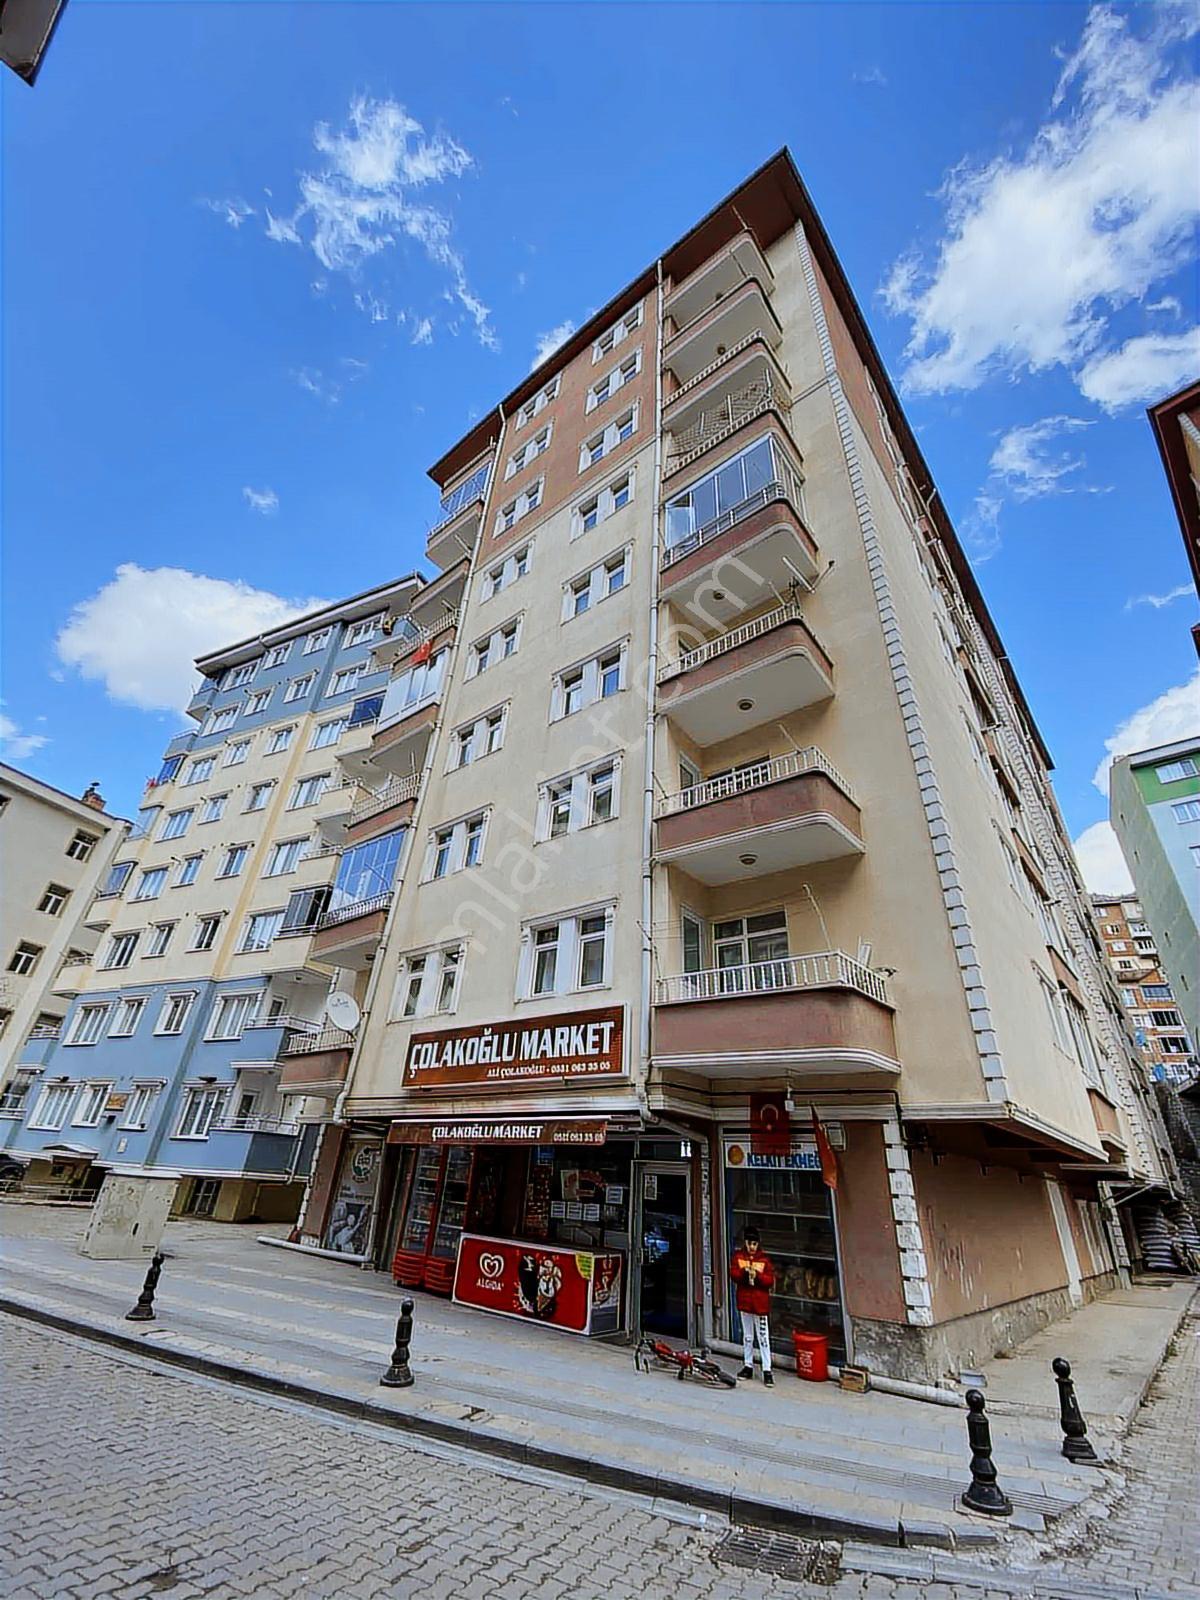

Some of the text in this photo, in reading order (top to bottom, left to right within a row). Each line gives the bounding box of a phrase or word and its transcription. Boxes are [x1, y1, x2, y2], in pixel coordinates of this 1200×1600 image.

[409, 1021, 615, 1079] ÇOLAKOĞLU MARKET
[431, 1123, 544, 1142] ÇOLAKOĞLU MARKET
[476, 1278, 502, 1291] ALGIDA
